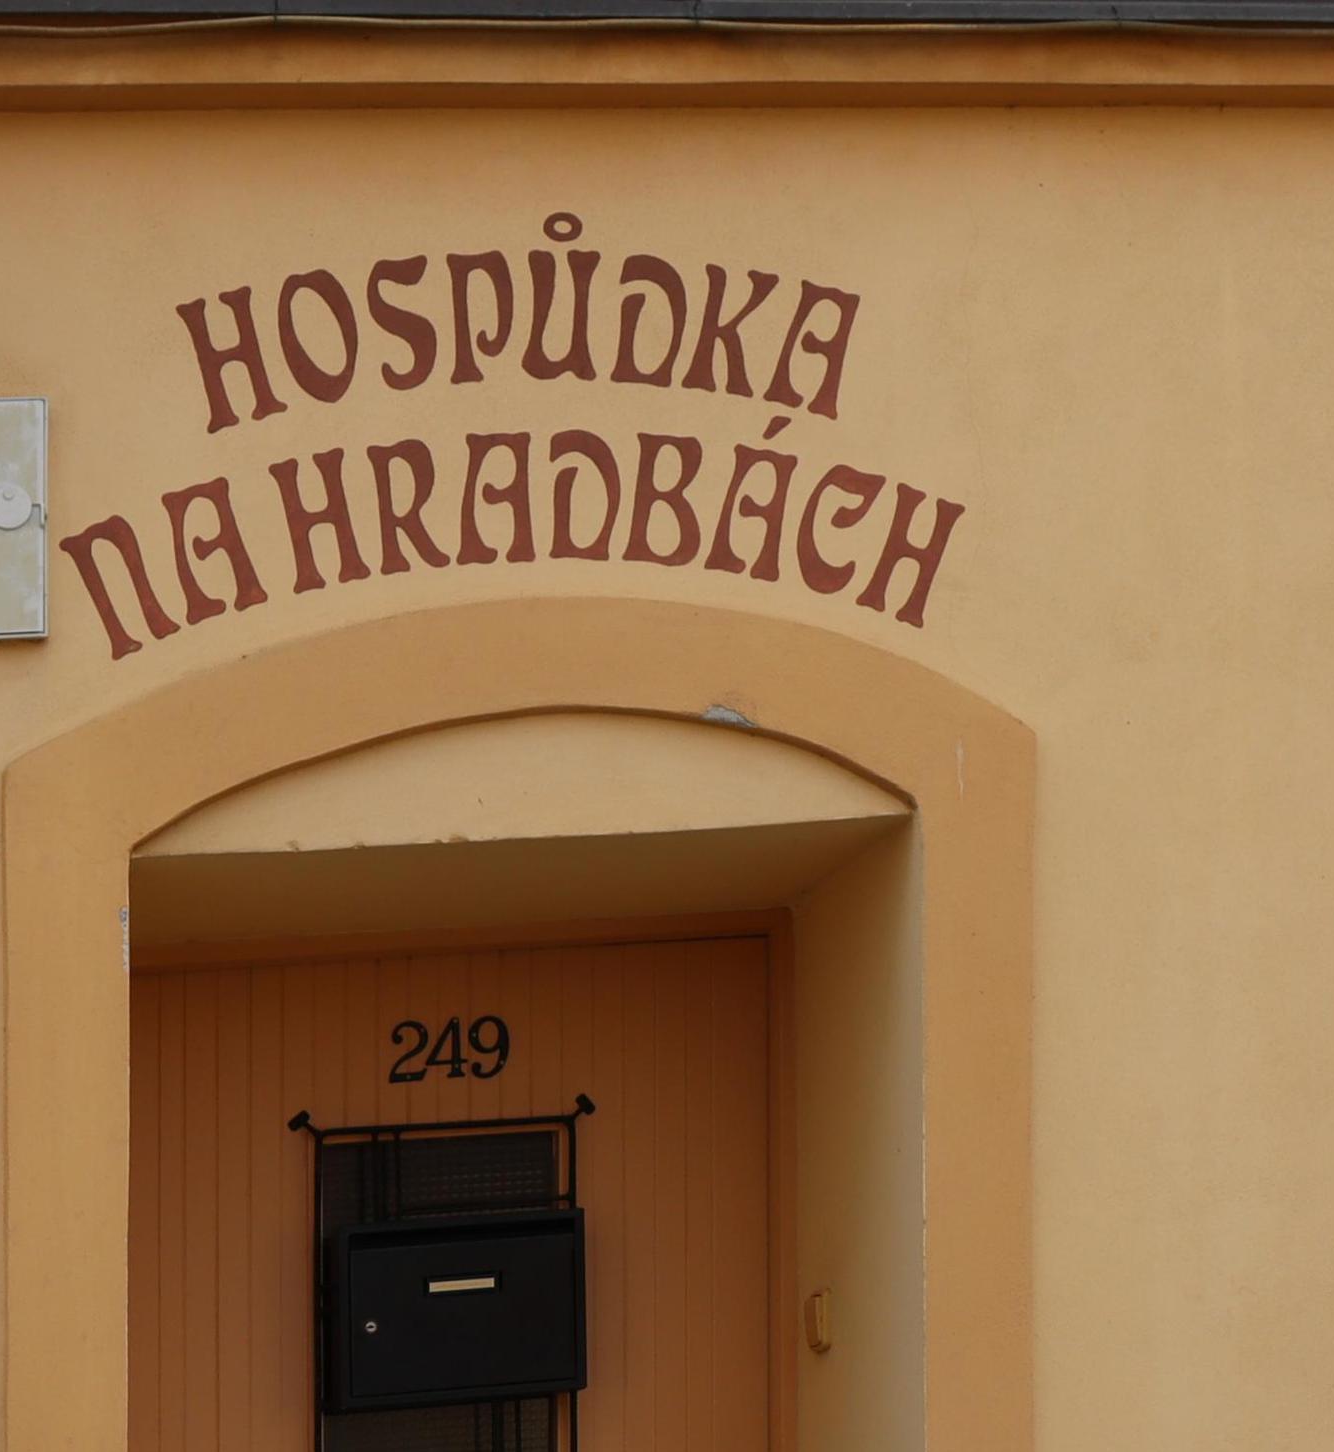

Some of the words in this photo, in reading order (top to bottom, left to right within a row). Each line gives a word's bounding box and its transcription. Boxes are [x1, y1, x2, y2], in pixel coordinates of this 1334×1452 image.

[175, 211, 861, 434] HOSPŮDKA
[58, 477, 269, 661] NA
[268, 415, 966, 629] HRADBÁCH
[388, 1015, 510, 1083] 249
